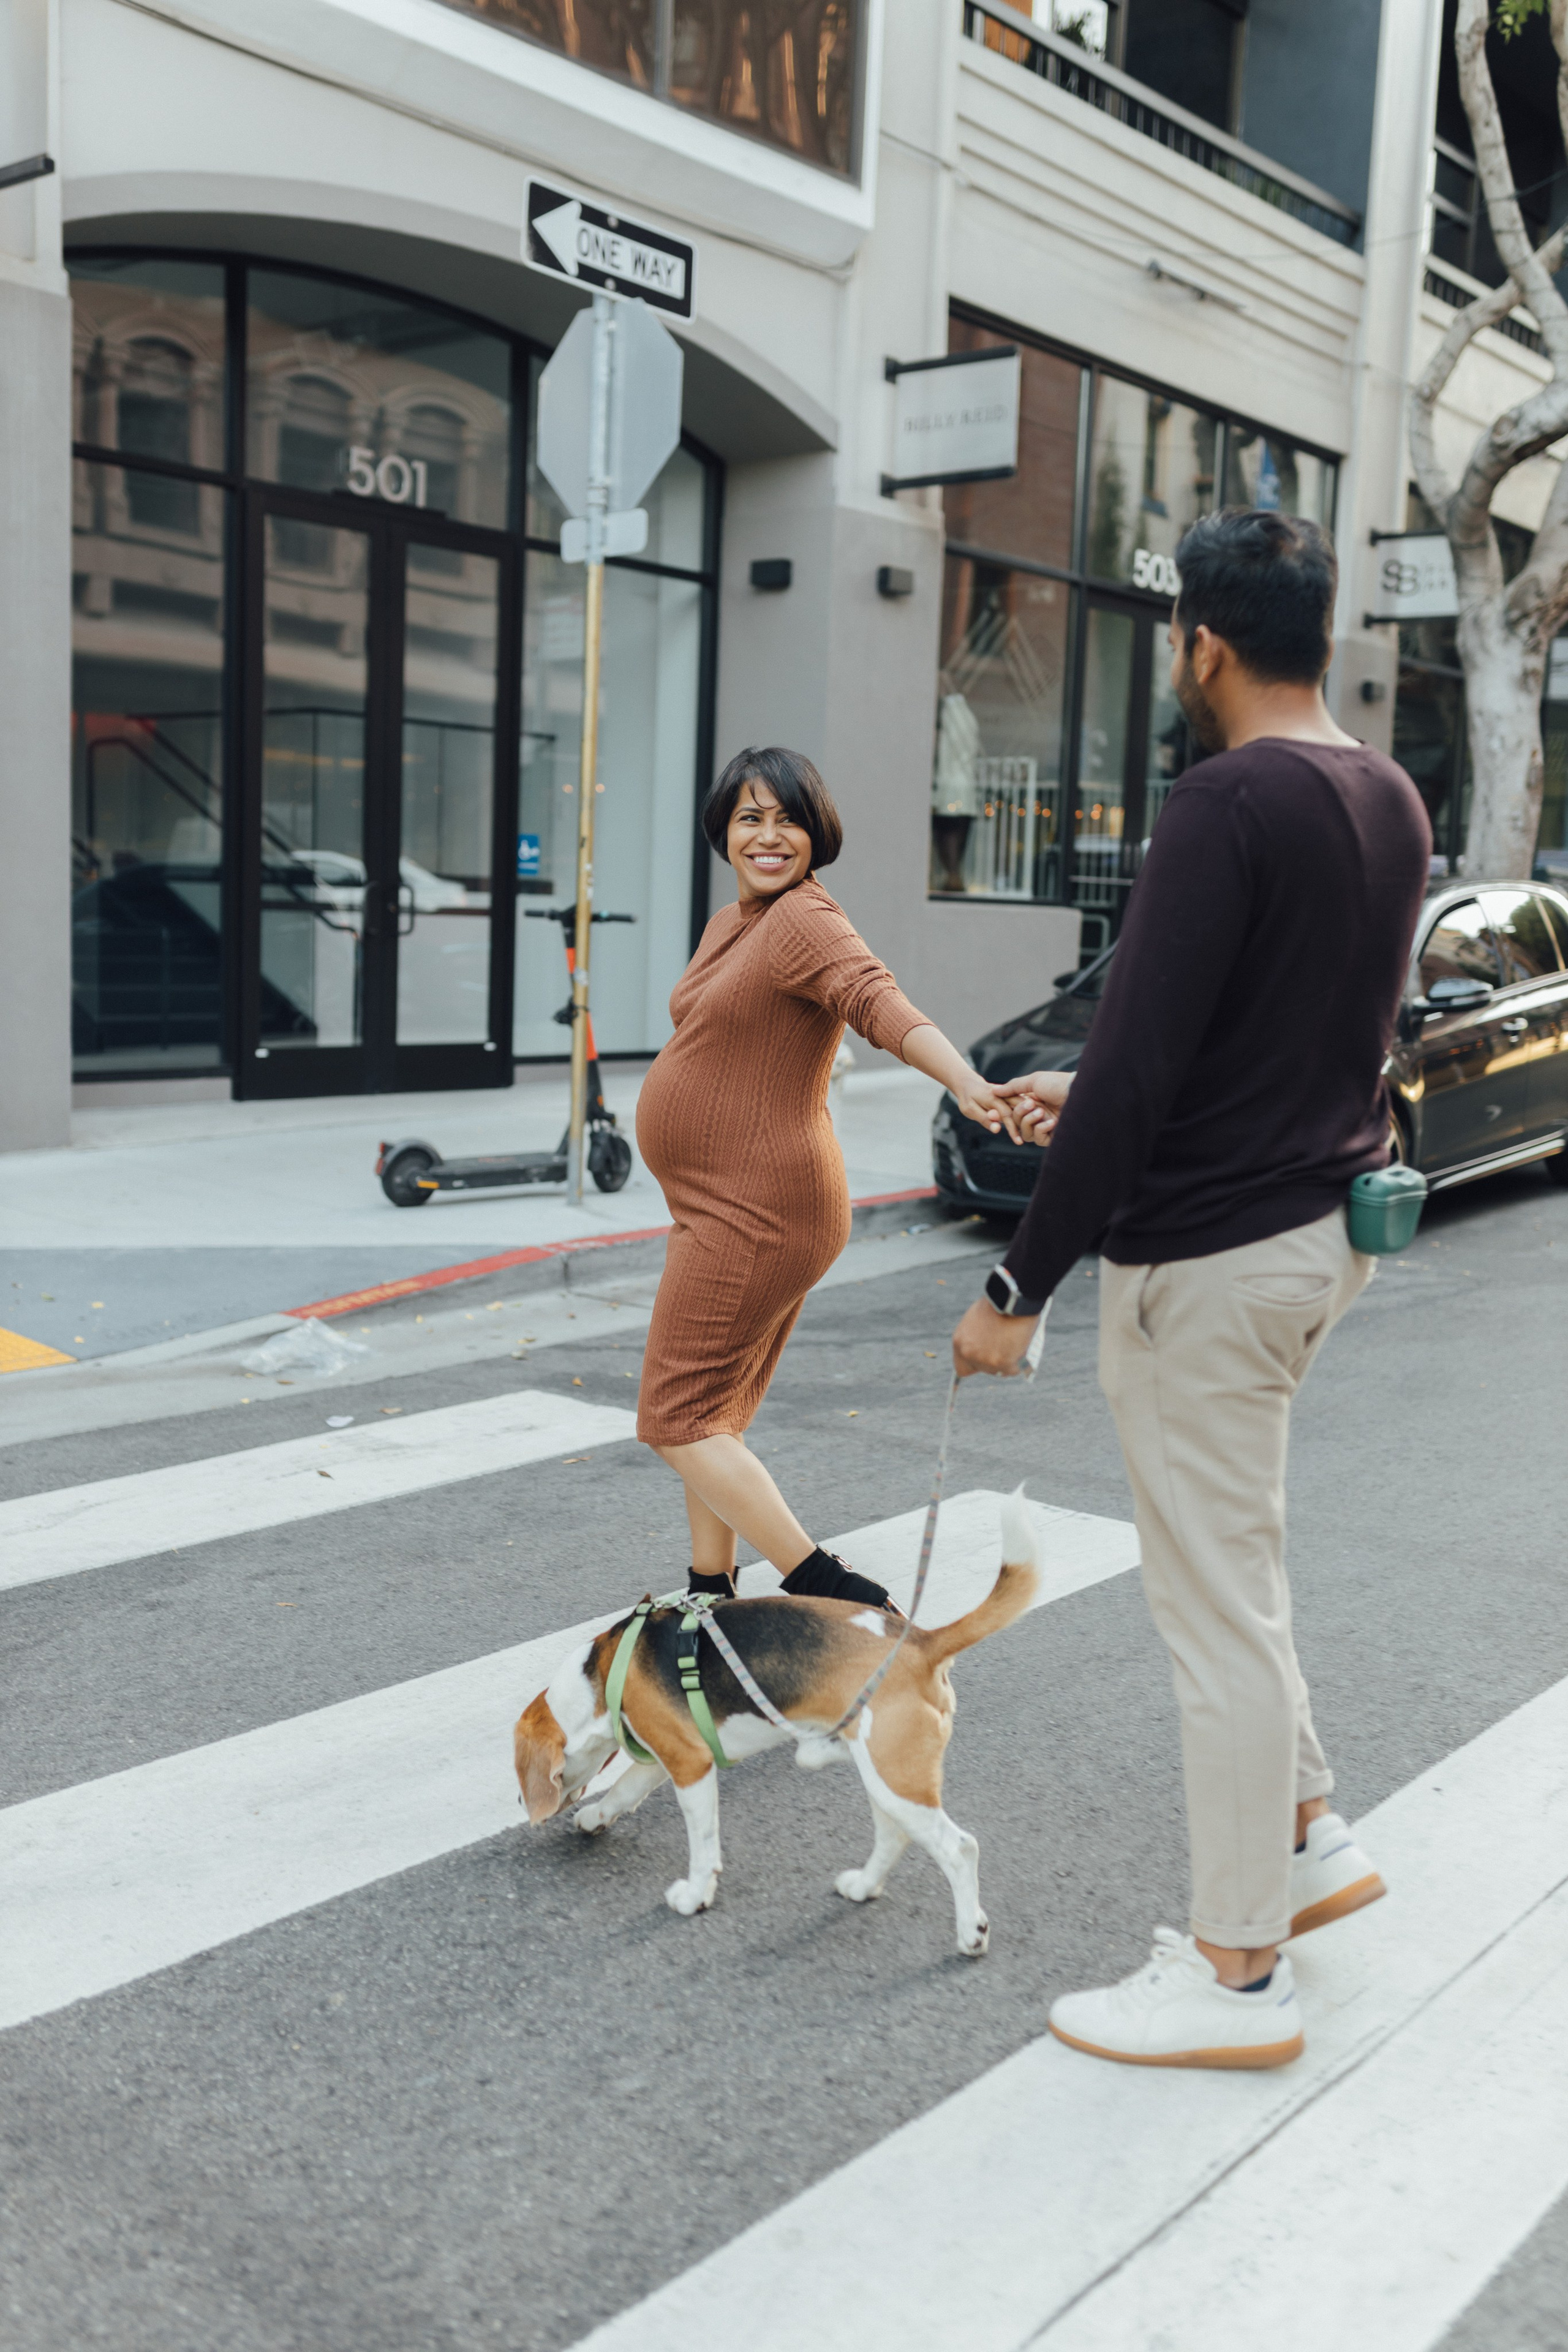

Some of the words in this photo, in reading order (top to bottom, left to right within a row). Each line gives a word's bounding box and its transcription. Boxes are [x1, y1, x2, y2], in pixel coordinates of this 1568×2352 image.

[576, 228, 623, 270] ONE
[630, 247, 677, 288] WAY
[347, 445, 428, 508] 501
